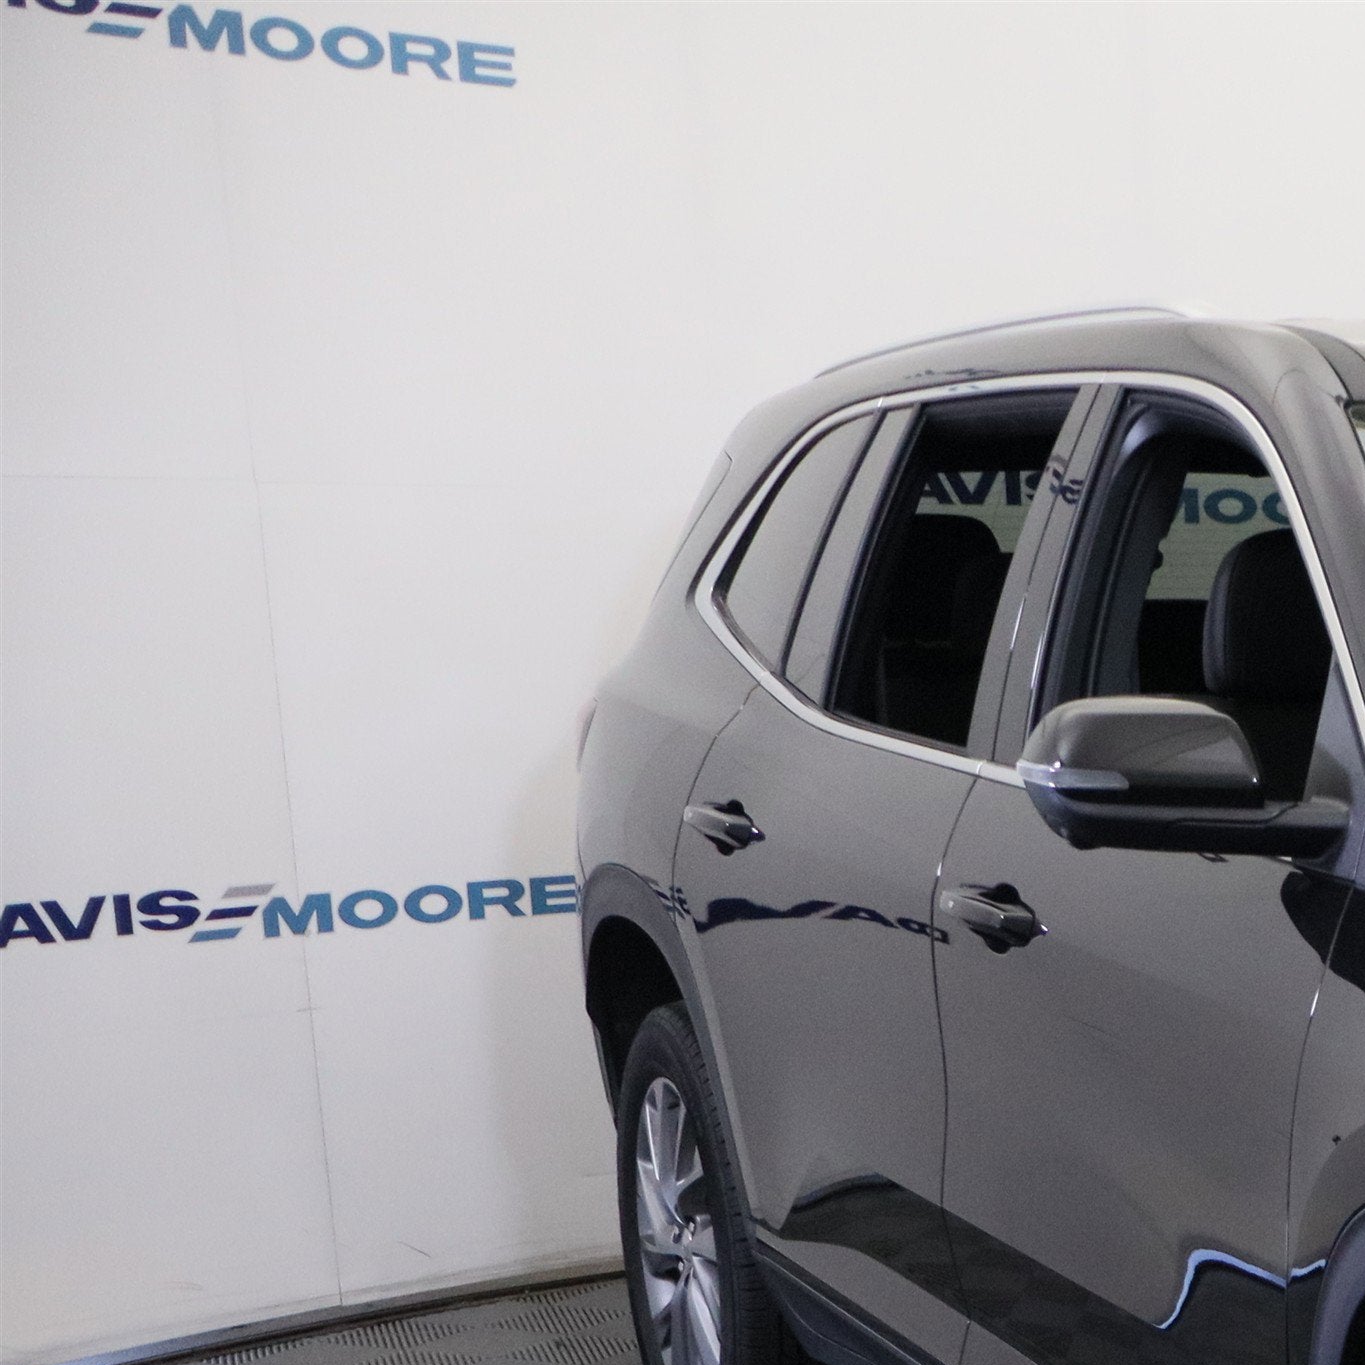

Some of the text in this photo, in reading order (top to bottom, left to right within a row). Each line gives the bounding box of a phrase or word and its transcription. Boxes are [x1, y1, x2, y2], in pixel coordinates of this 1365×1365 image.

[167, 3, 516, 88] MOORE
[0, 874, 579, 949] AVIS MOORE
